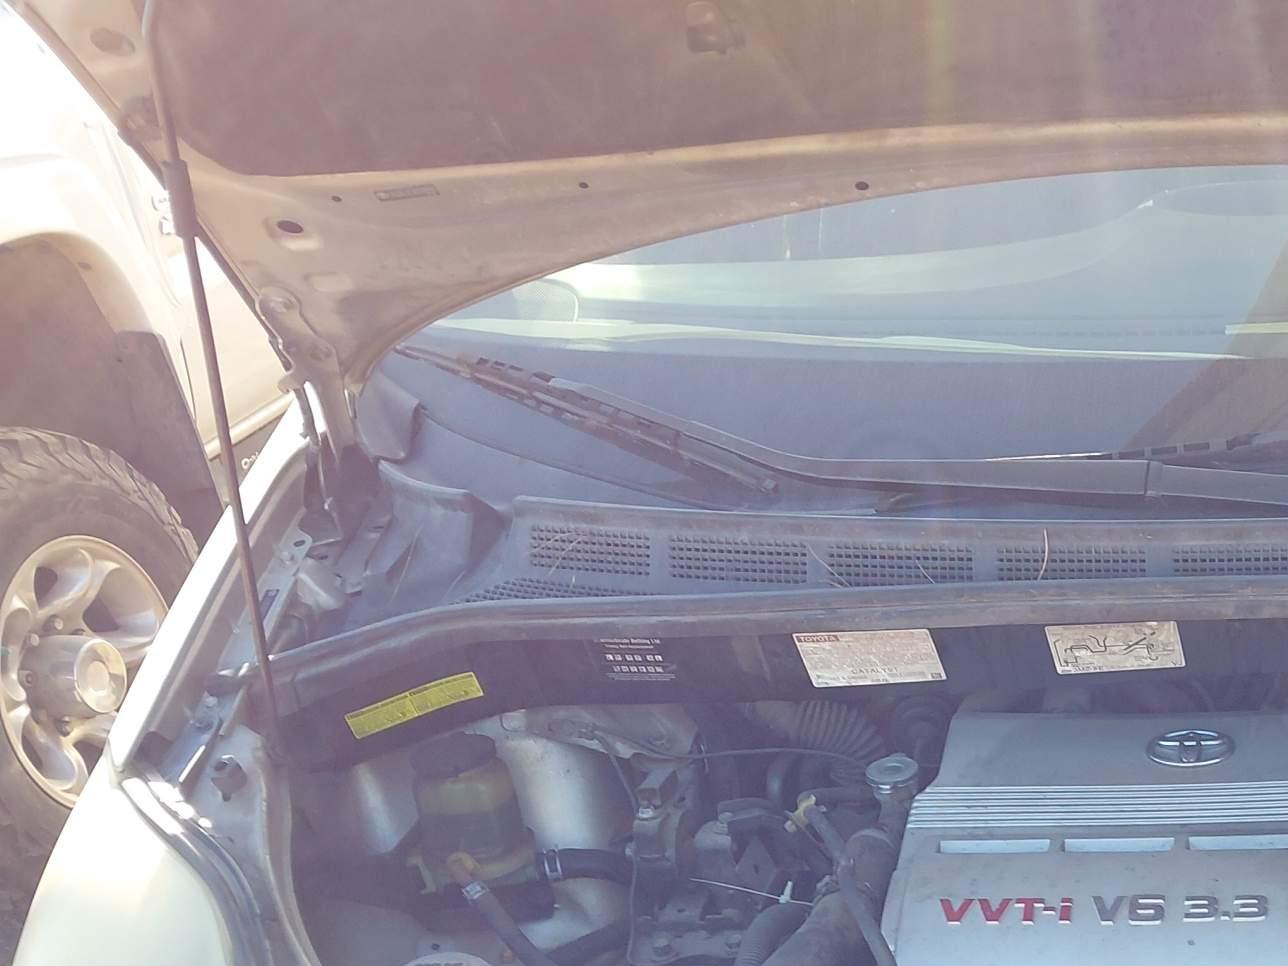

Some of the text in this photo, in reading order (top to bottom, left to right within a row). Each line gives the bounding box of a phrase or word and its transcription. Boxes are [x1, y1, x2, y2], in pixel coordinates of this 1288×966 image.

[939, 894, 1268, 926] VVT-i V6 3.3
